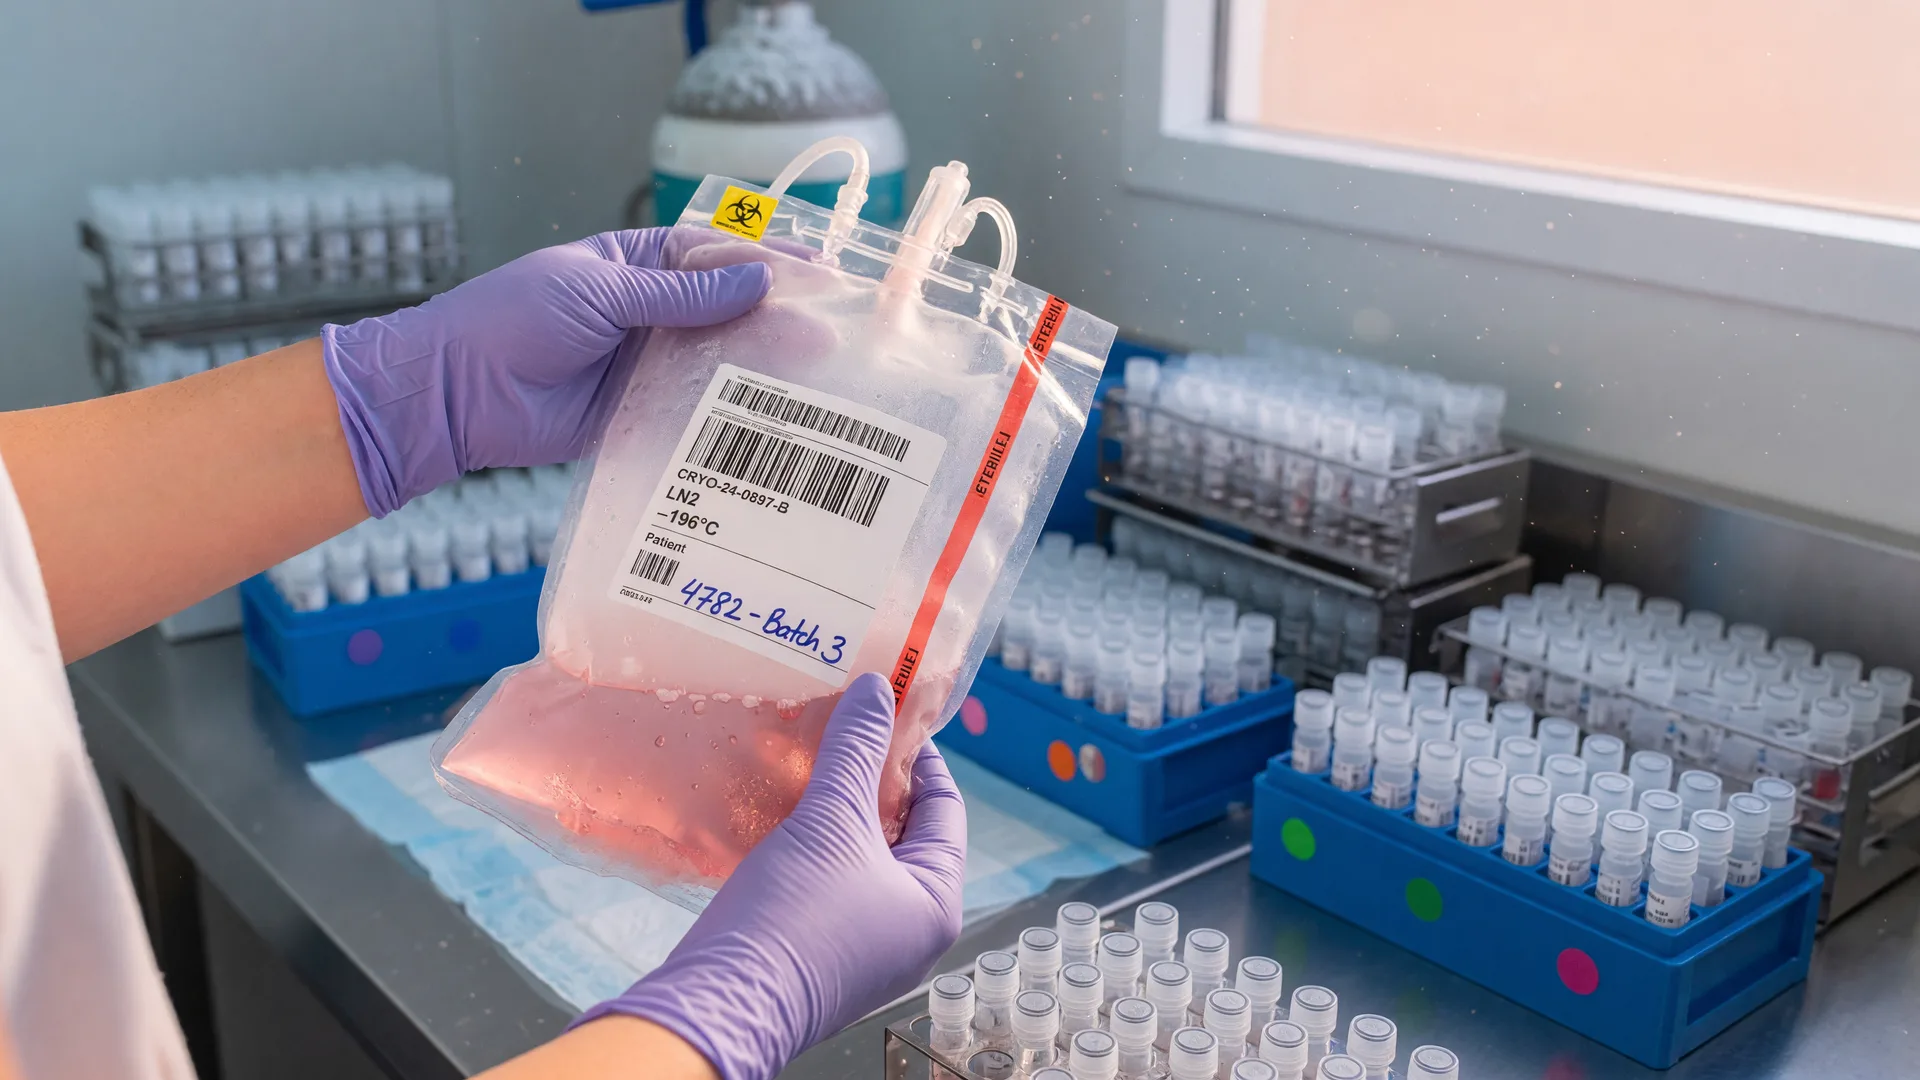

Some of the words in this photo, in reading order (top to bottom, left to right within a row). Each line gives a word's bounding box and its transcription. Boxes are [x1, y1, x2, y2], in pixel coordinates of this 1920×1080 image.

[665, 485, 701, 507] LN2
[677, 468, 790, 514] CRYO-24-0897-B
[644, 532, 687, 554] Patient
[681, 578, 743, 621] 4782
[762, 607, 820, 652] Batch
[820, 635, 847, 664] 3
